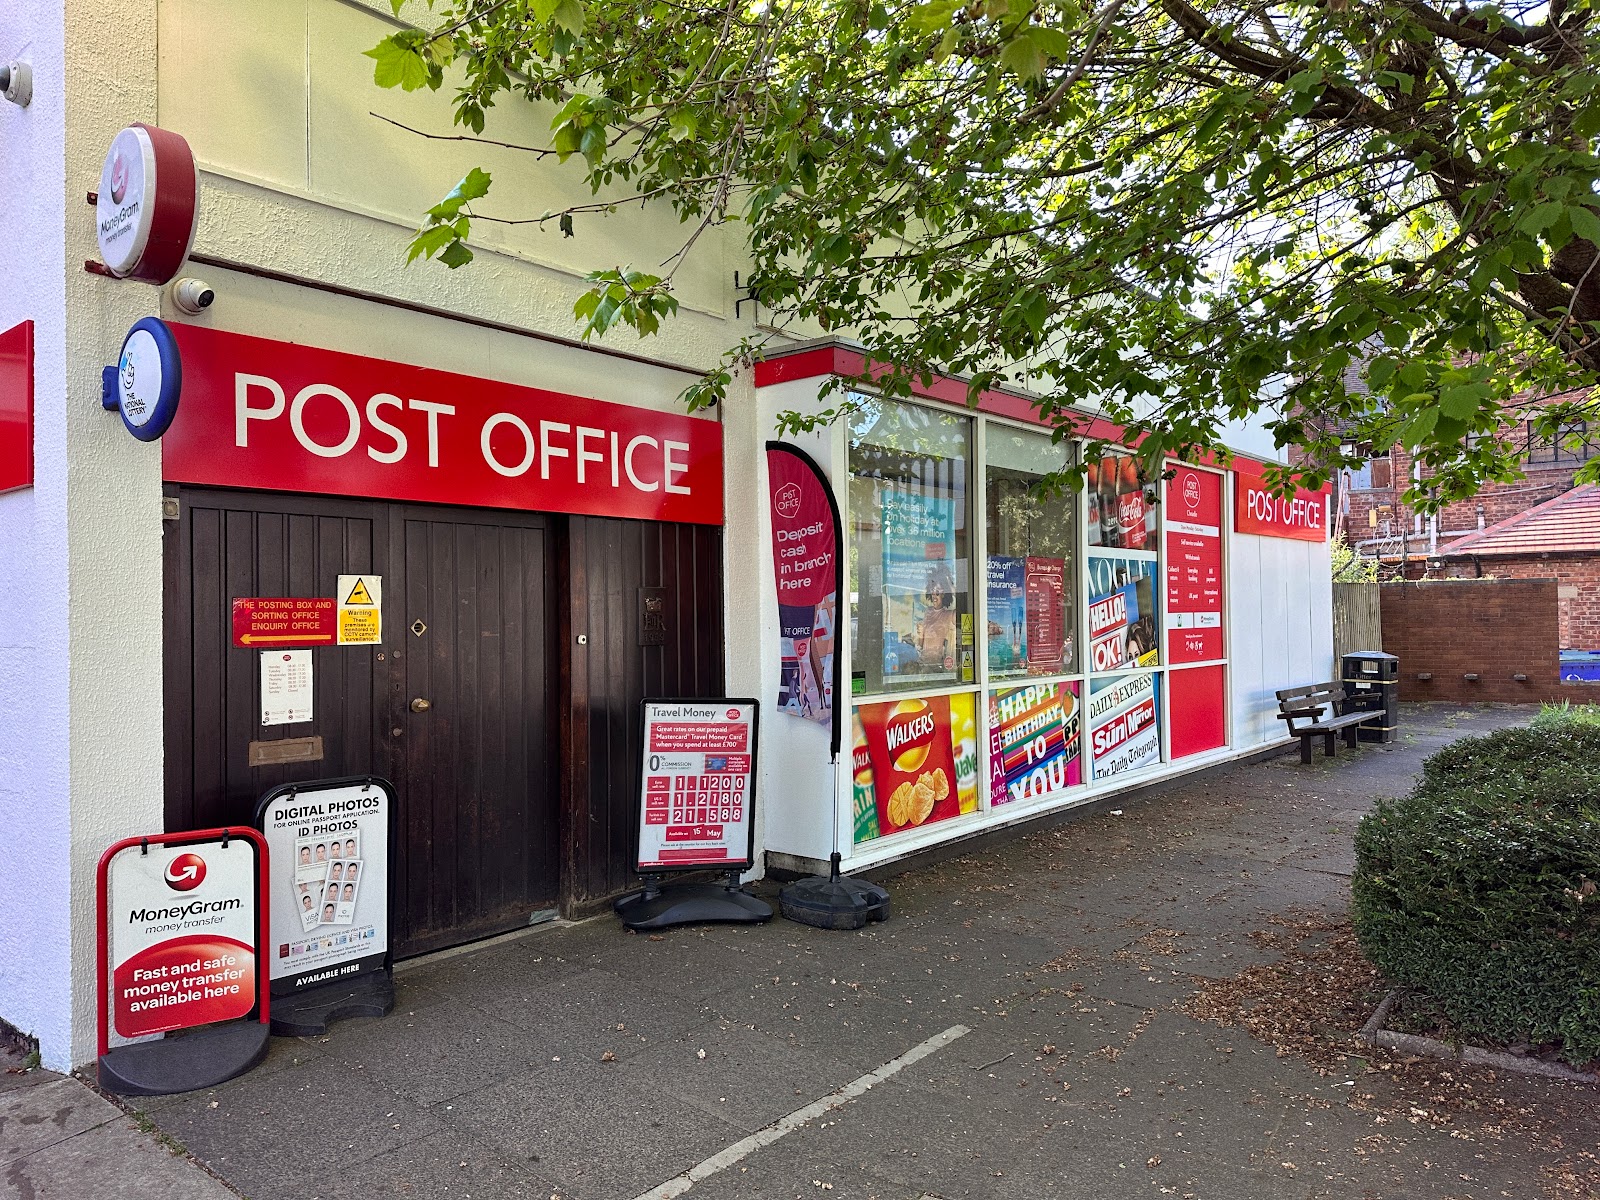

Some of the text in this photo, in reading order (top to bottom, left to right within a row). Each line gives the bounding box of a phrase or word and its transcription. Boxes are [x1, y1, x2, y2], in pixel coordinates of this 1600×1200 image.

[101, 202, 139, 235] MoneyGram
[124, 399, 145, 409] NATIONAL
[235, 372, 691, 495] POST OFFICE
[1187, 480, 1197, 490] POST
[1185, 489, 1199, 499] OFFICE
[904, 503, 928, 515] easily
[1247, 489, 1321, 529] POST OFFICE
[900, 514, 930, 528] holiday
[931, 517, 940, 526] at
[777, 522, 823, 542] Deposit
[920, 528, 945, 539] million
[780, 562, 792, 574] in
[987, 561, 1012, 570] 20% off
[780, 577, 812, 590] here
[258, 601, 293, 609] POSTING
[296, 601, 313, 609] BOX
[251, 611, 320, 620] SORTING OFFICE
[1091, 595, 1126, 633] HELLO!
[251, 622, 288, 631] ENQUIRY
[1095, 636, 1122, 671] OK!
[1000, 683, 1056, 723] HAPPY
[1090, 672, 1153, 720] DAILY EXPRESS
[652, 707, 716, 720] Travel Money
[1126, 707, 1153, 735] Mirror
[706, 726, 728, 734] prepaid
[886, 712, 935, 752] WALKERS
[1004, 706, 1060, 747] BIRTHDAY
[684, 741, 701, 749] spend
[708, 734, 728, 742] Money
[1094, 723, 1125, 755] Sun
[1023, 735, 1047, 765] TO
[1096, 735, 1158, 780] The Daily Telegraph
[677, 777, 744, 788] 1.1200
[1010, 754, 1066, 800] YOU
[677, 793, 742, 805] 1.2180
[275, 797, 379, 821] DIGITAL PHOTOS
[674, 809, 741, 822] 21.588
[287, 818, 310, 827] ONLINE
[311, 814, 341, 823] PASSPORT
[298, 820, 358, 837] ID PHOTOS
[693, 827, 701, 835] 15
[706, 830, 722, 838] May
[129, 897, 241, 924] MoneyGram
[305, 912, 319, 922] VISA
[145, 915, 225, 935] money transfer
[133, 954, 236, 982] Fast and safe
[295, 963, 360, 987] AVAILABLE HERE
[123, 967, 246, 999] money transfer
[130, 983, 240, 1013] available here
